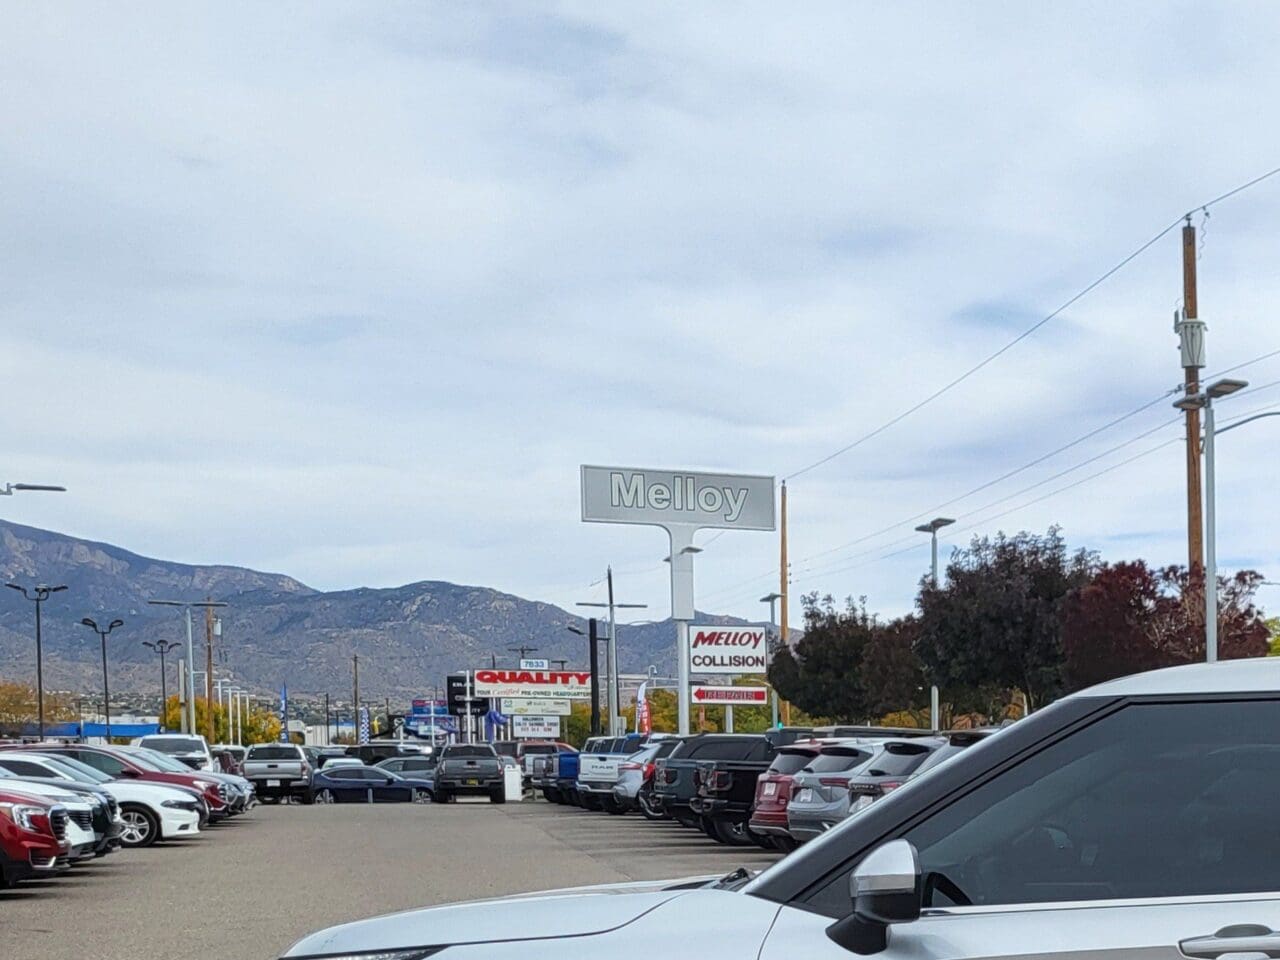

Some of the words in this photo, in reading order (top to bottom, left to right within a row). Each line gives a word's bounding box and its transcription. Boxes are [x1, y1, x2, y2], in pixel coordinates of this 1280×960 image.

[610, 472, 749, 522] Melloy
[692, 631, 764, 649] MELLOY
[692, 655, 765, 667] COLLISION
[476, 671, 592, 685] QUALITY
